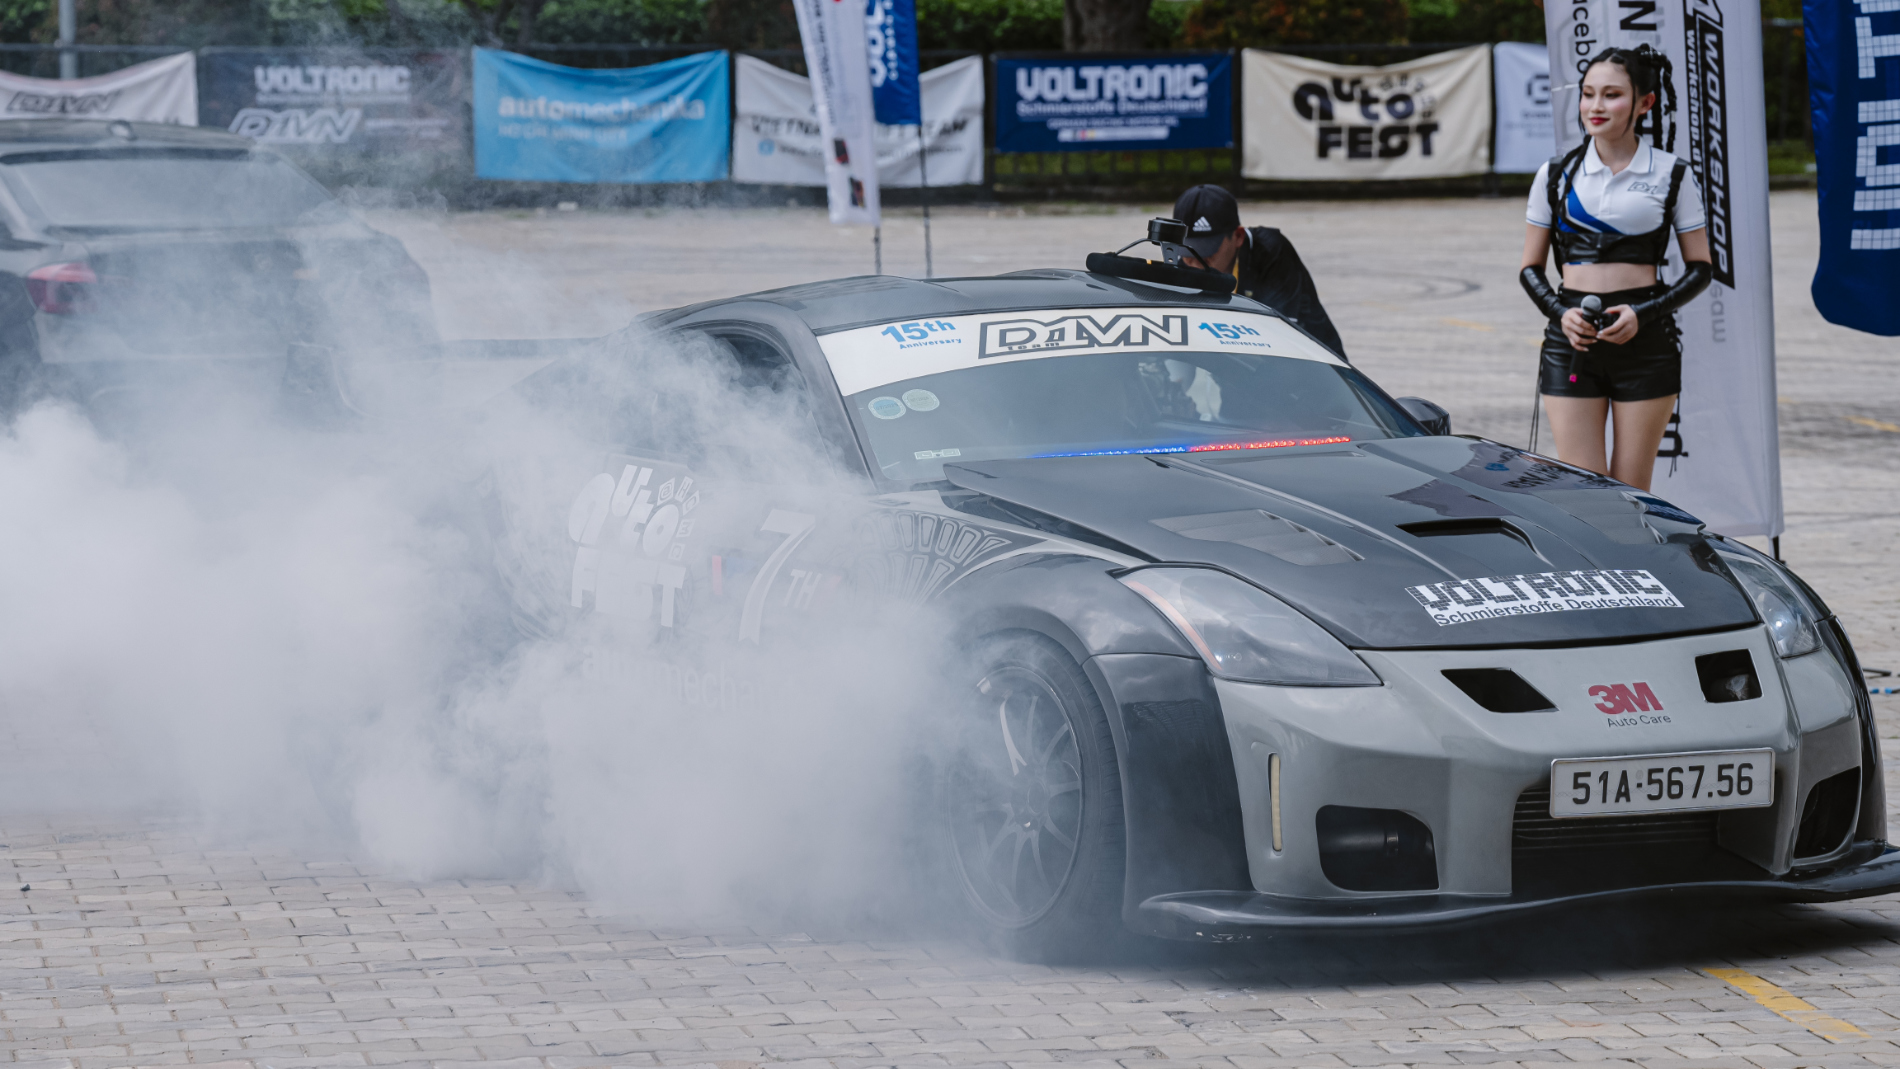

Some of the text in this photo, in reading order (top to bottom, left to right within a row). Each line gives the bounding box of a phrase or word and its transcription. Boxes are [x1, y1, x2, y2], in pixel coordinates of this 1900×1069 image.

[254, 66, 411, 92] VOLTRONIC
[1016, 64, 1208, 101] VOLTRONIC
[1686, 30, 1703, 174] workshop.d1
[1317, 123, 1439, 158] FEST
[1704, 33, 1729, 274] WORKSHOP
[881, 319, 956, 344] 15th
[899, 336, 962, 350] Anniversary
[1007, 341, 1060, 352] team
[1198, 322, 1260, 341] 15th
[1219, 338, 1271, 349] Anniversary
[1405, 569, 1664, 612] VOLTRONIC
[1433, 595, 1678, 626] Schmierstoffe Deutschland
[1588, 682, 1664, 715] 3M
[1607, 714, 1672, 728] Auto Care
[1571, 762, 1754, 805] 51A-567.56
